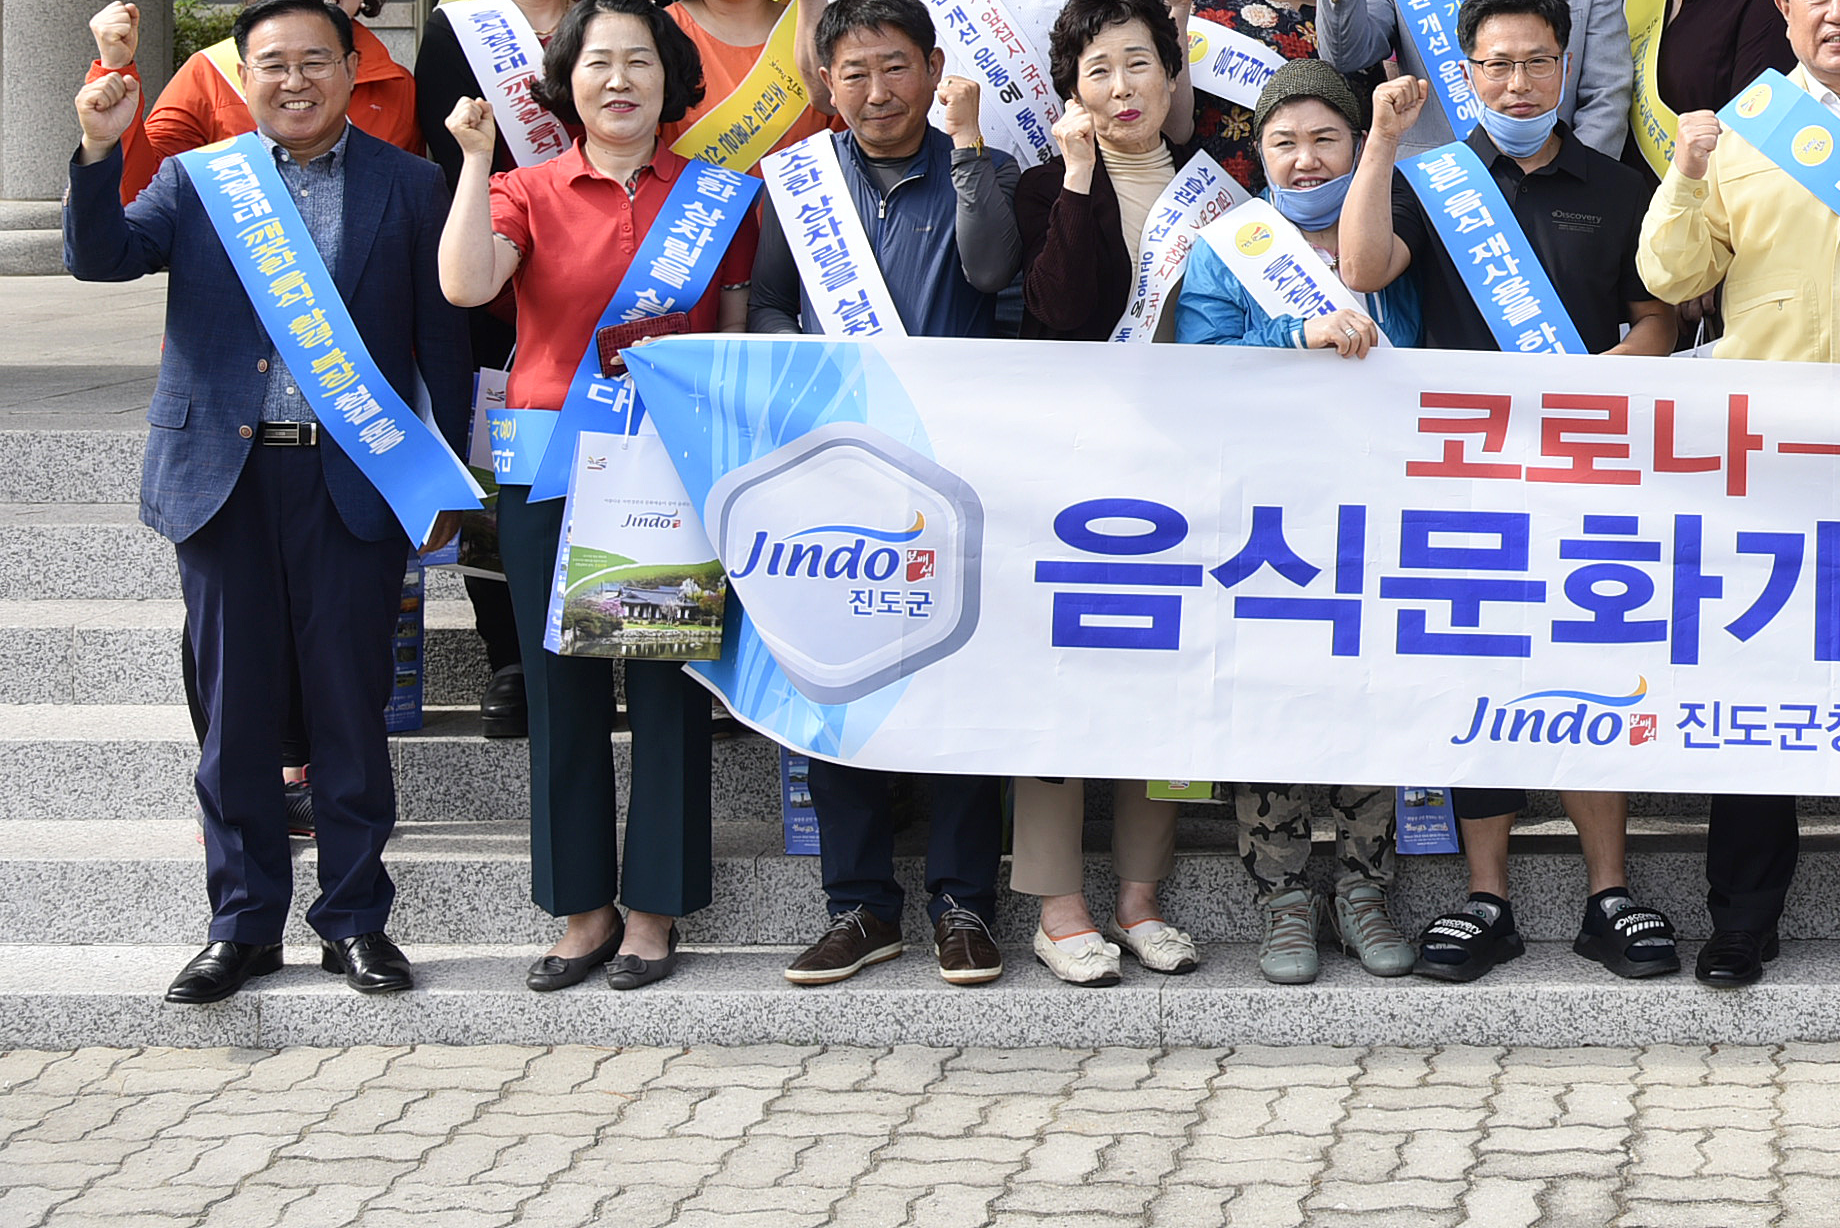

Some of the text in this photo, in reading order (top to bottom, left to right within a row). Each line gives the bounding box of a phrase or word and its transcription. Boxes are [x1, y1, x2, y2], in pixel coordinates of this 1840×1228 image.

[944, 5, 980, 46] 개선
[973, 47, 1024, 104] 운동에
[1418, 13, 1451, 56] 개선
[1213, 45, 1275, 91] 음식점3
[697, 167, 742, 203] 소한
[776, 139, 822, 197] 소한
[795, 195, 858, 292] 상차림을
[1130, 167, 1216, 318] 식습관 개선 운동에
[1417, 153, 1543, 327] 남은 음식 재사용을
[621, 514, 670, 528] Jindo
[730, 530, 900, 582] Jindo
[848, 589, 934, 618] 진도군
[1451, 696, 1620, 746] Jindo
